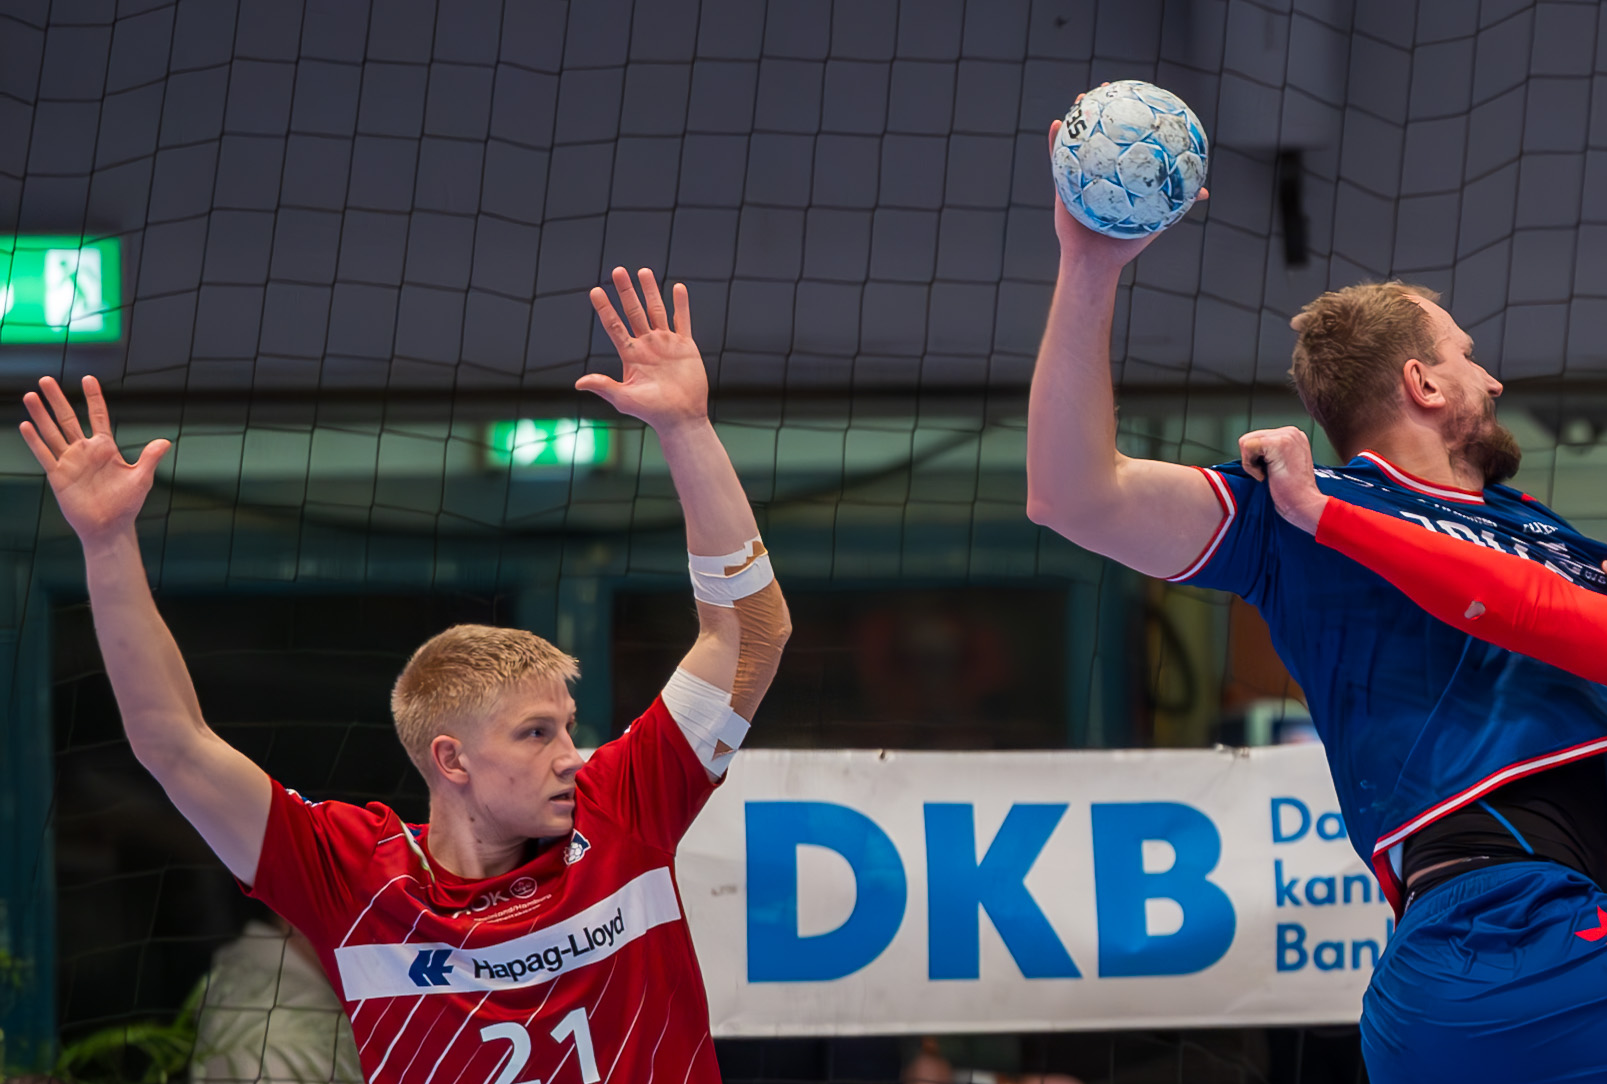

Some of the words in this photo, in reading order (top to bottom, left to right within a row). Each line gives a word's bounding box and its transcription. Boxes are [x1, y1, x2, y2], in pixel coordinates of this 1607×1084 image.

[1270, 796, 1349, 844] Da
[744, 800, 1237, 984] DKB
[472, 907, 625, 982] Hapag-Lloyd
